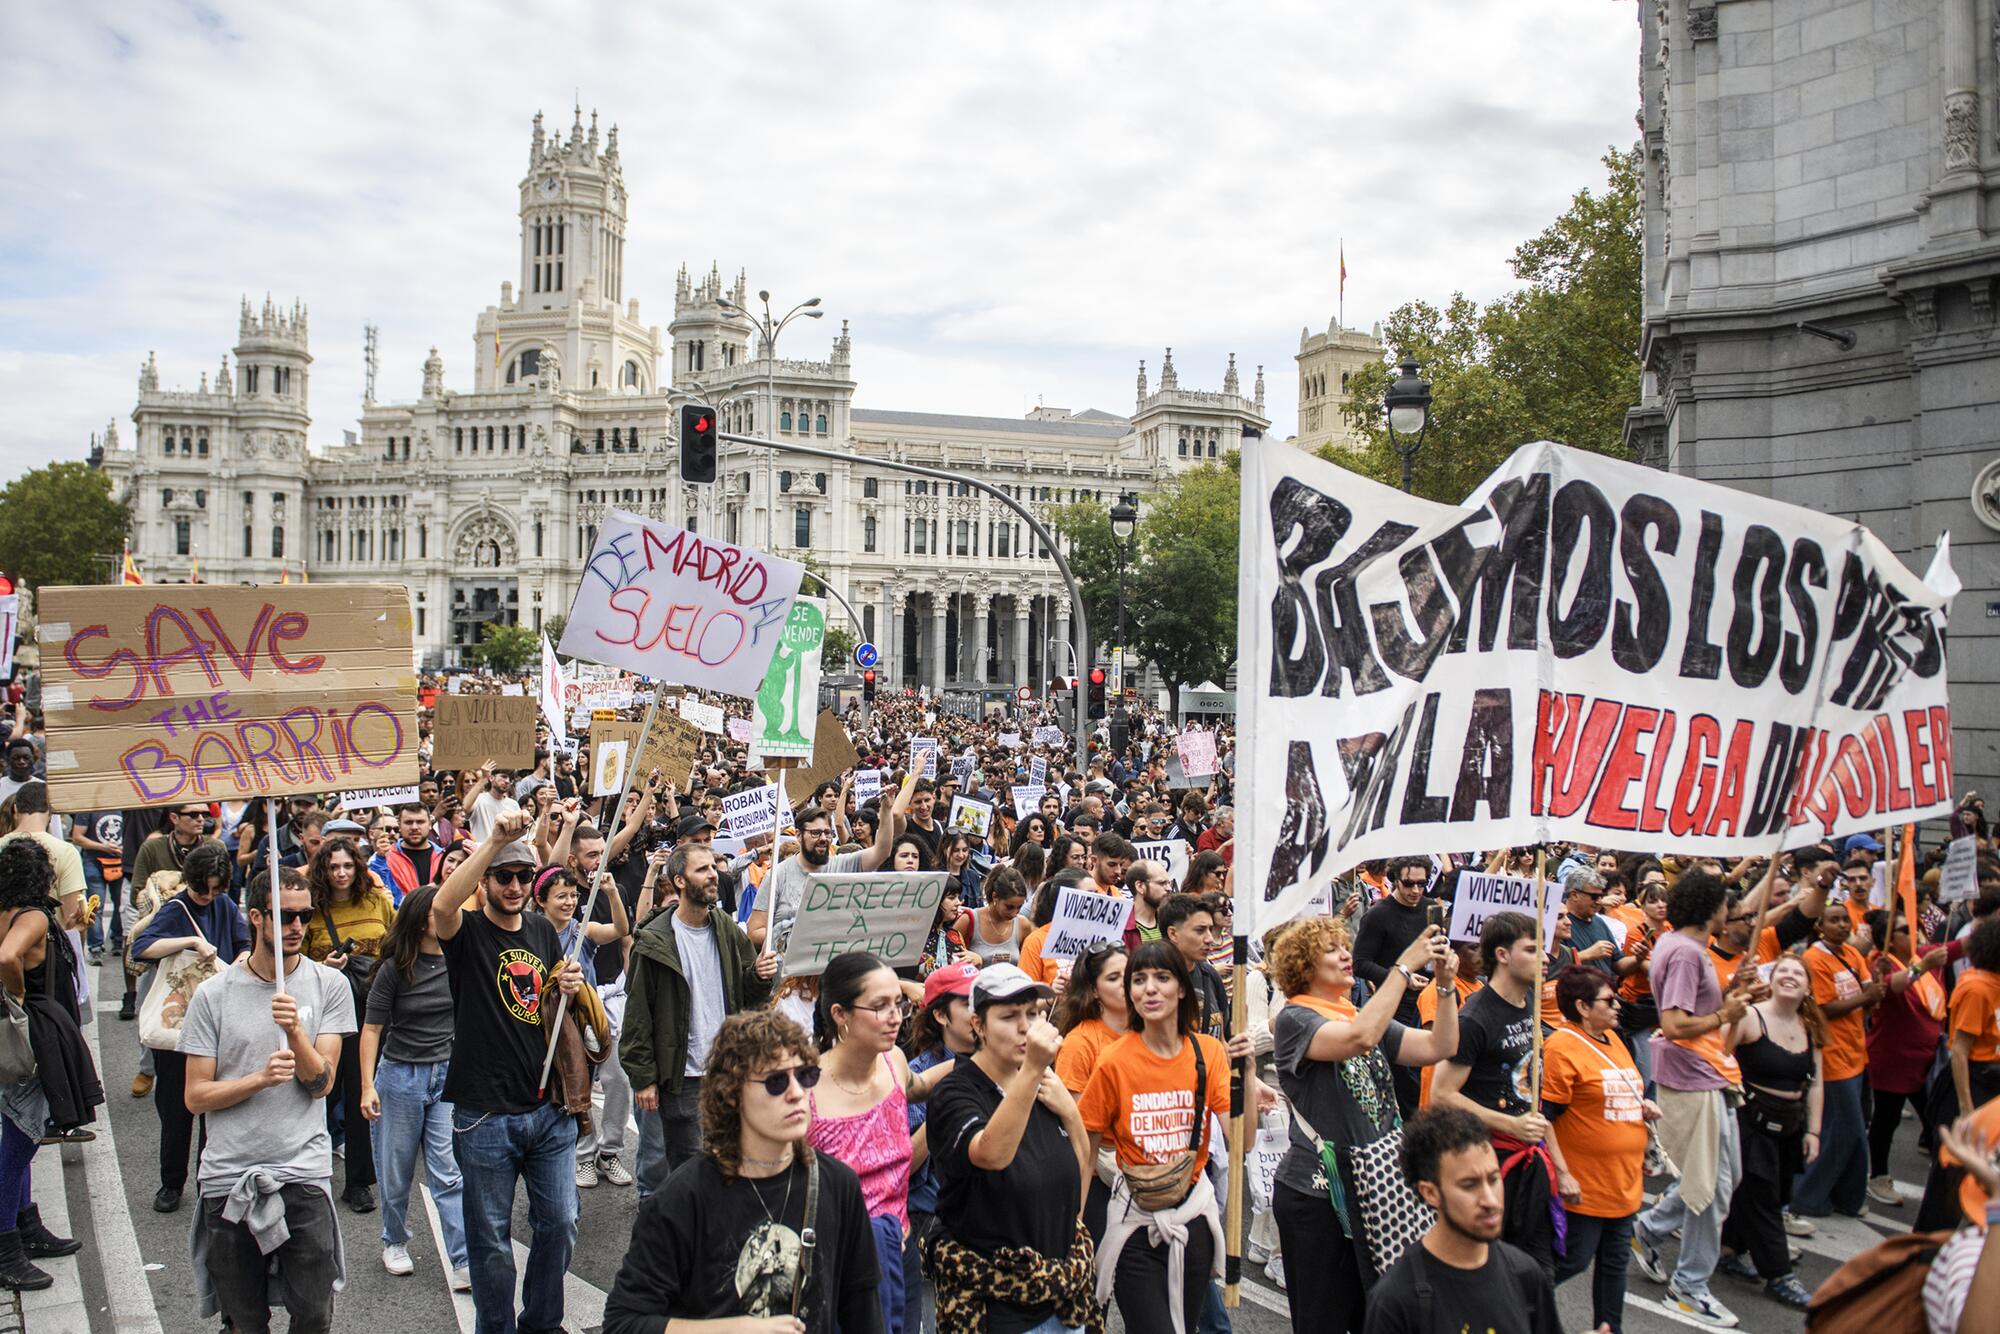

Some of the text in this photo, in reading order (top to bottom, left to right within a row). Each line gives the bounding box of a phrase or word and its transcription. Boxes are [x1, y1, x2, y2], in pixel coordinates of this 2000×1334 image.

[586, 532, 647, 593] DE
[792, 605, 809, 622] SE
[1679, 508, 1829, 696] LOS
[595, 585, 746, 667] SUELO
[784, 624, 820, 643] VENDE
[149, 689, 243, 738] THE
[438, 699, 460, 726] LA
[1399, 688, 1514, 825] LA
[1530, 688, 1755, 838] HUELGA
[724, 790, 763, 813] ROBAN
[734, 808, 769, 830] CENSURAN
[805, 879, 941, 913] DERECHO
[1468, 876, 1533, 909] VIVIENDA
[1063, 892, 1110, 924] VIVIENDA
[846, 914, 868, 935] A
[510, 951, 544, 974] SUAVES
[1131, 1089, 1193, 1111] SINDICATO
[1134, 1115, 1150, 1131] DE
